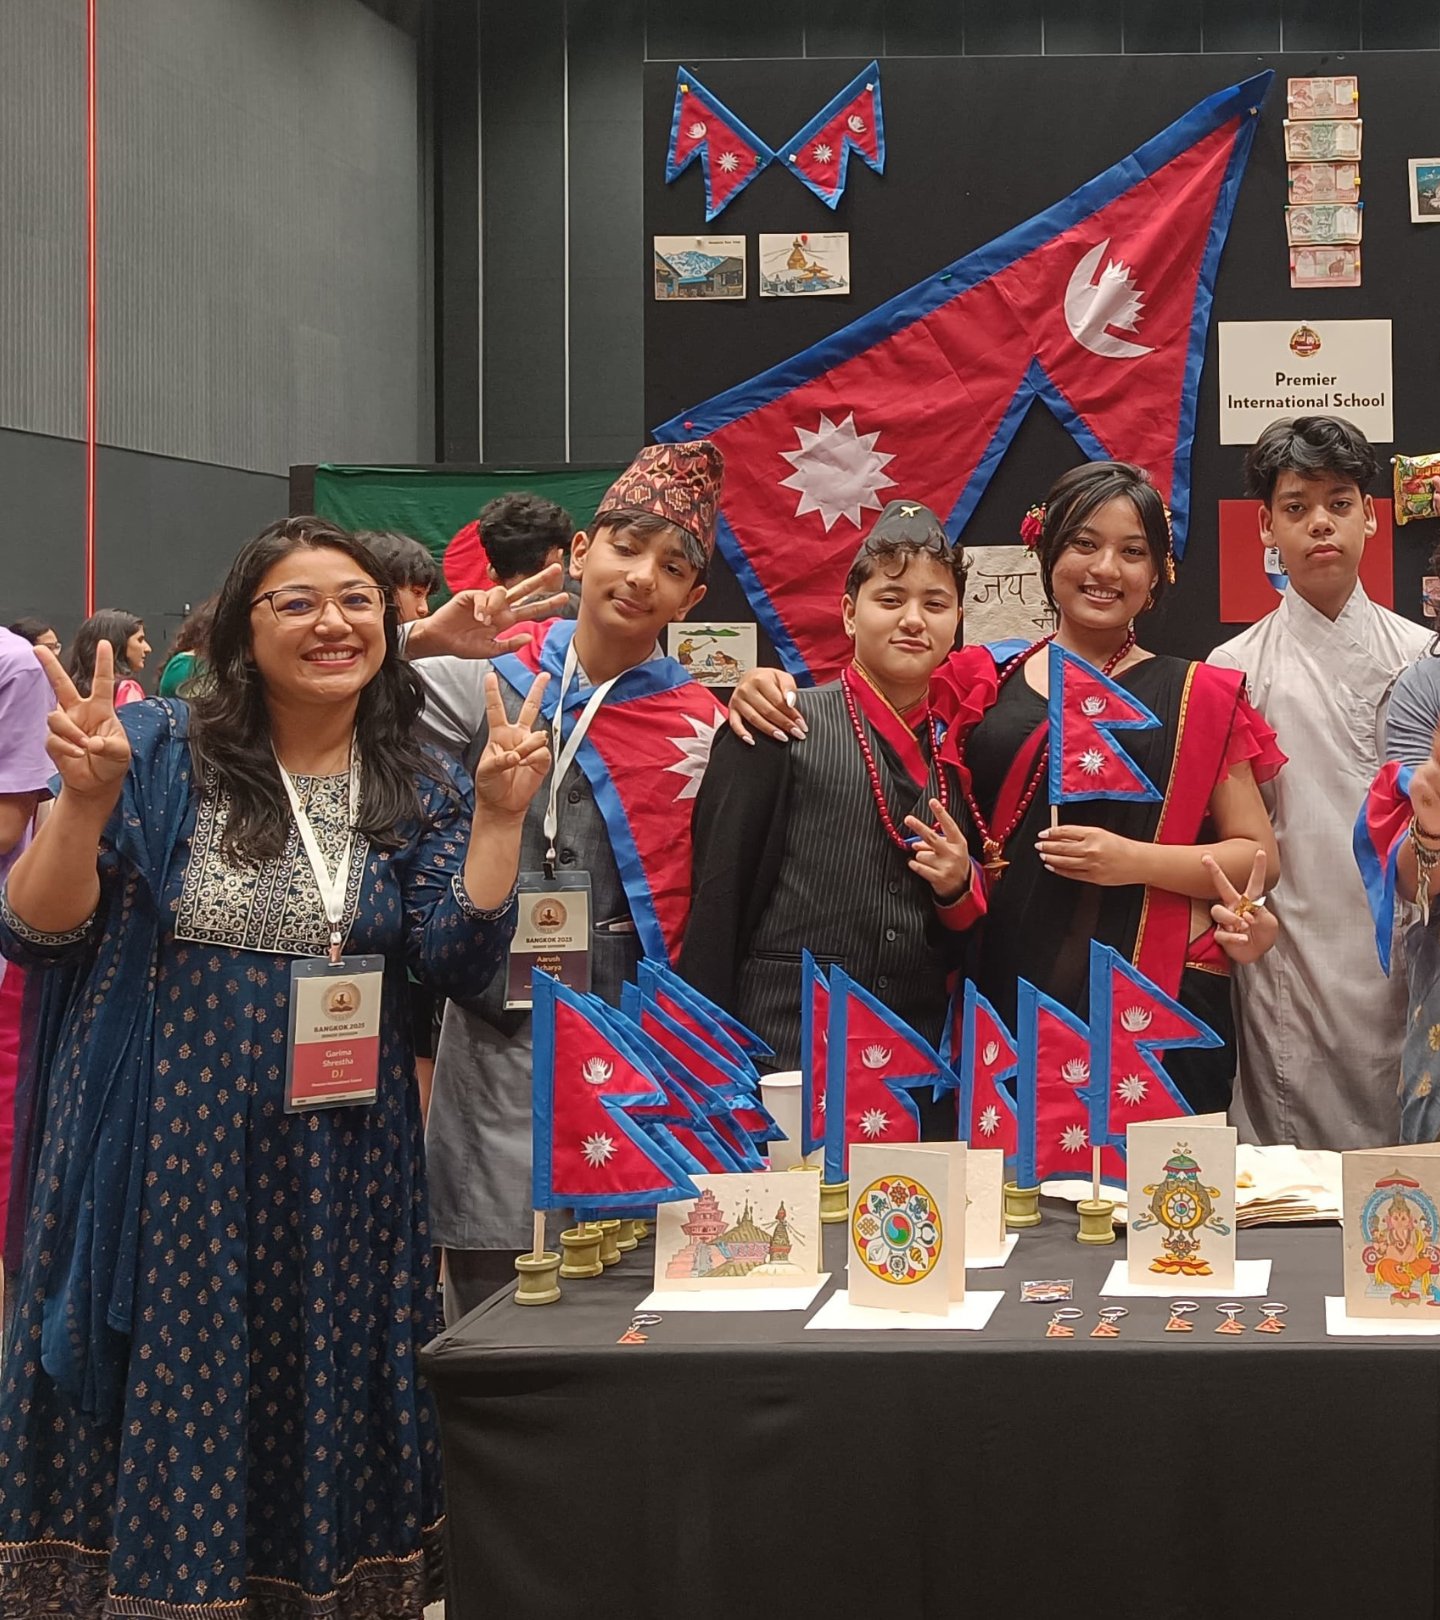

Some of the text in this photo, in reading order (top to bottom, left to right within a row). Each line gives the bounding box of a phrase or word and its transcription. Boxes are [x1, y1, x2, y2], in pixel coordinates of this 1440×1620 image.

[1275, 372, 1337, 387] Premier
[1228, 392, 1385, 409] International School
[314, 1024, 349, 1033] BANGKOK
[325, 1049, 352, 1058] Garima
[322, 1058, 354, 1067] Shrestha
